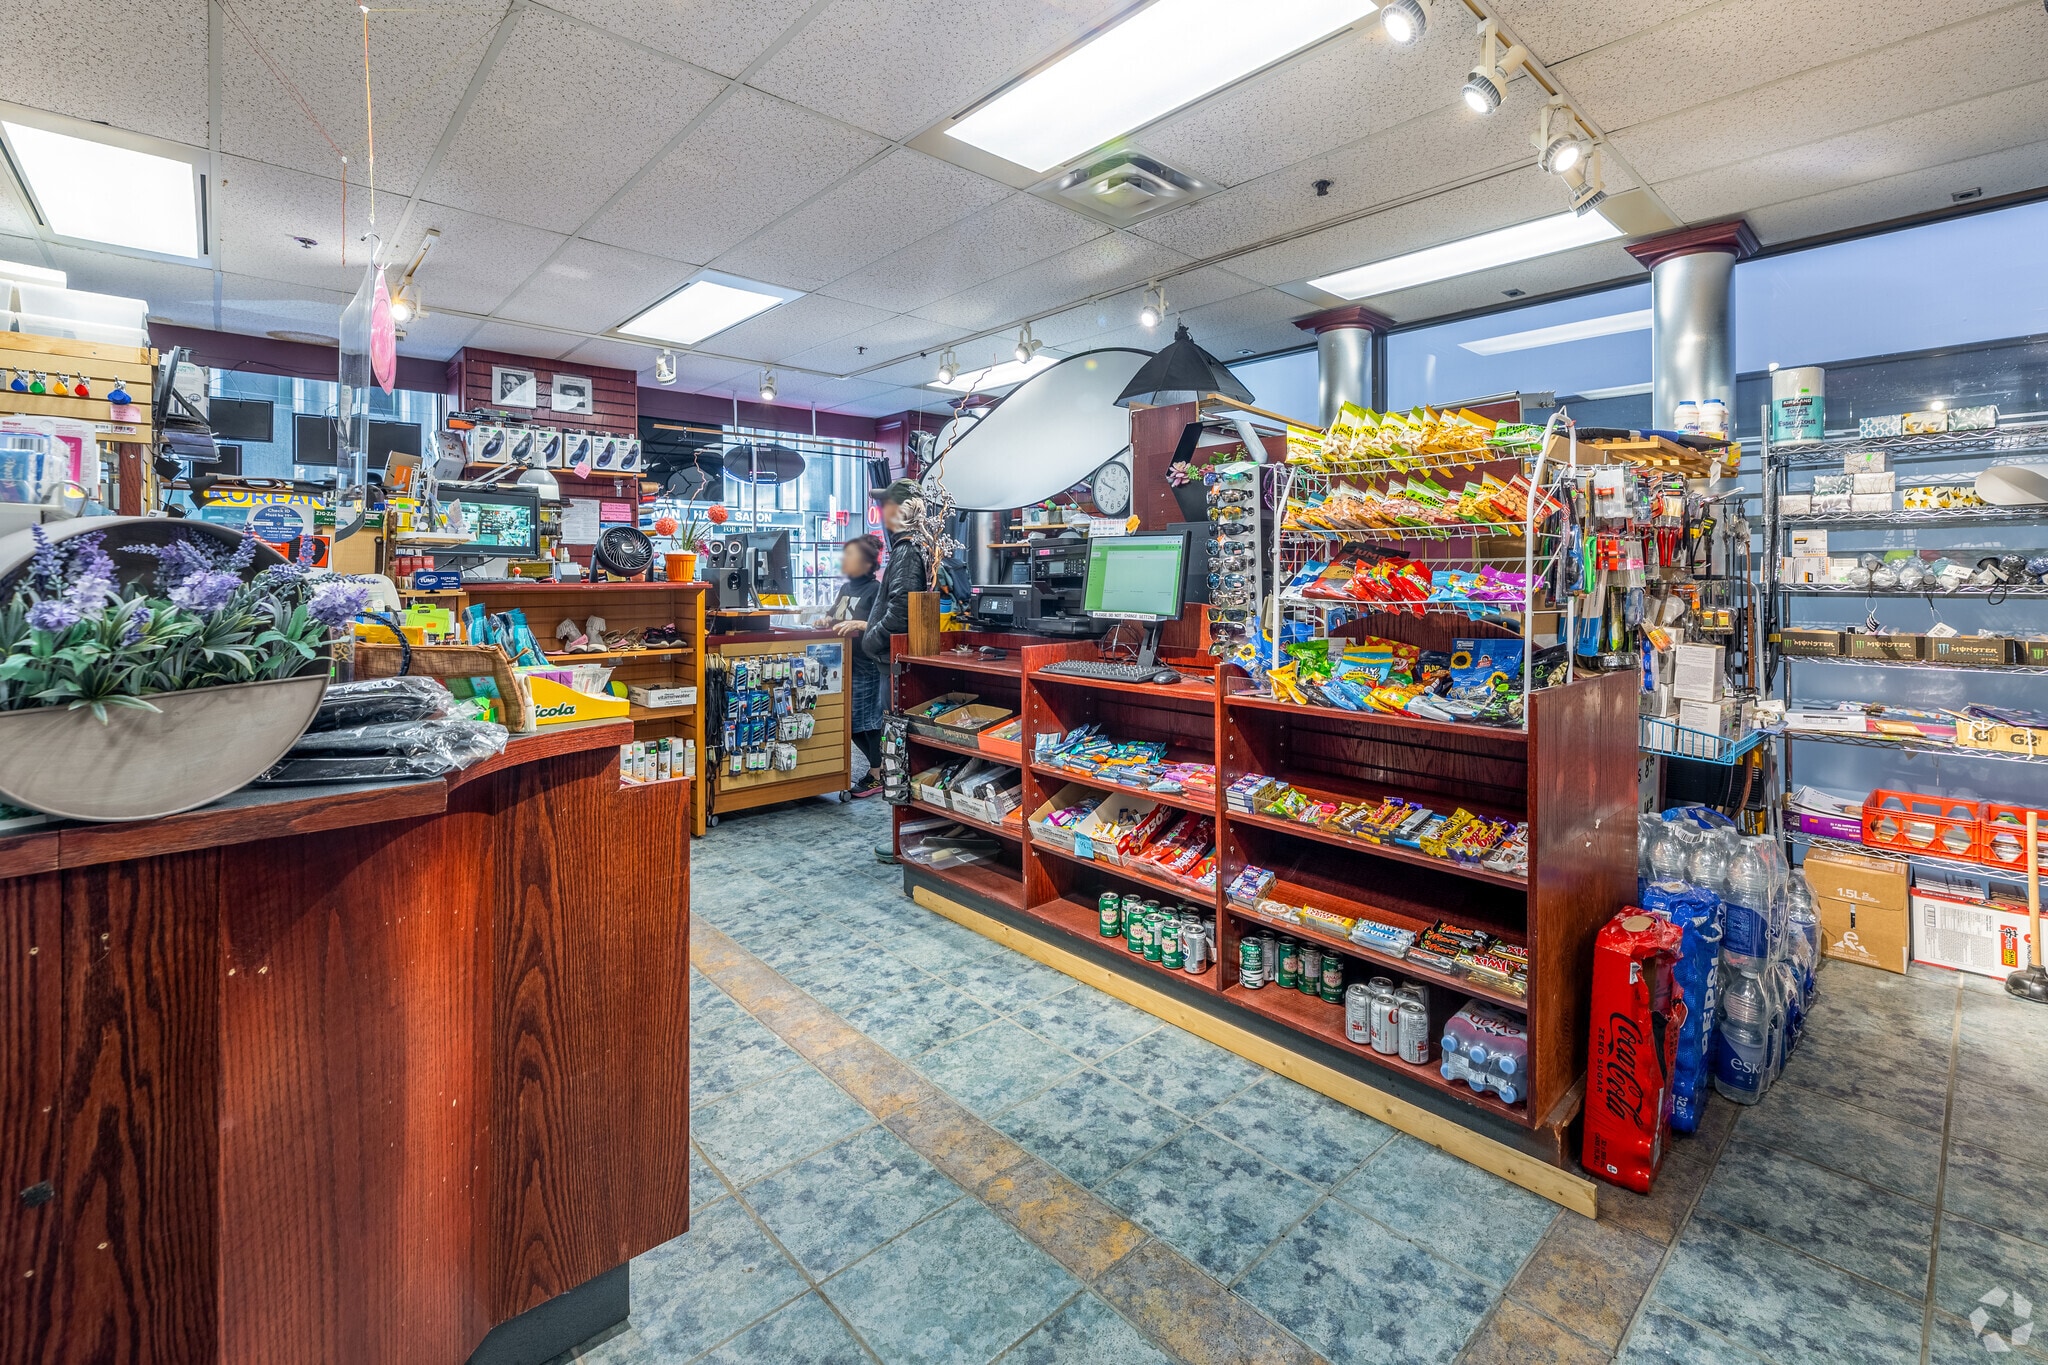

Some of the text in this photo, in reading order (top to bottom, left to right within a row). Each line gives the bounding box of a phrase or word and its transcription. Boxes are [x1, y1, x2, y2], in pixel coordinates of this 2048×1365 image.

[1793, 640, 1835, 648] MONSTER
[1950, 646, 1998, 654] MONSTER
[535, 703, 576, 718] icola
[1837, 887, 1862, 900] 1.5L
[1358, 926, 1396, 941] BOUNTY
[1361, 919, 1400, 934] BOUNTY
[1470, 1014, 1520, 1035] evian
[1596, 1026, 1606, 1094] ZERO SUGAR
